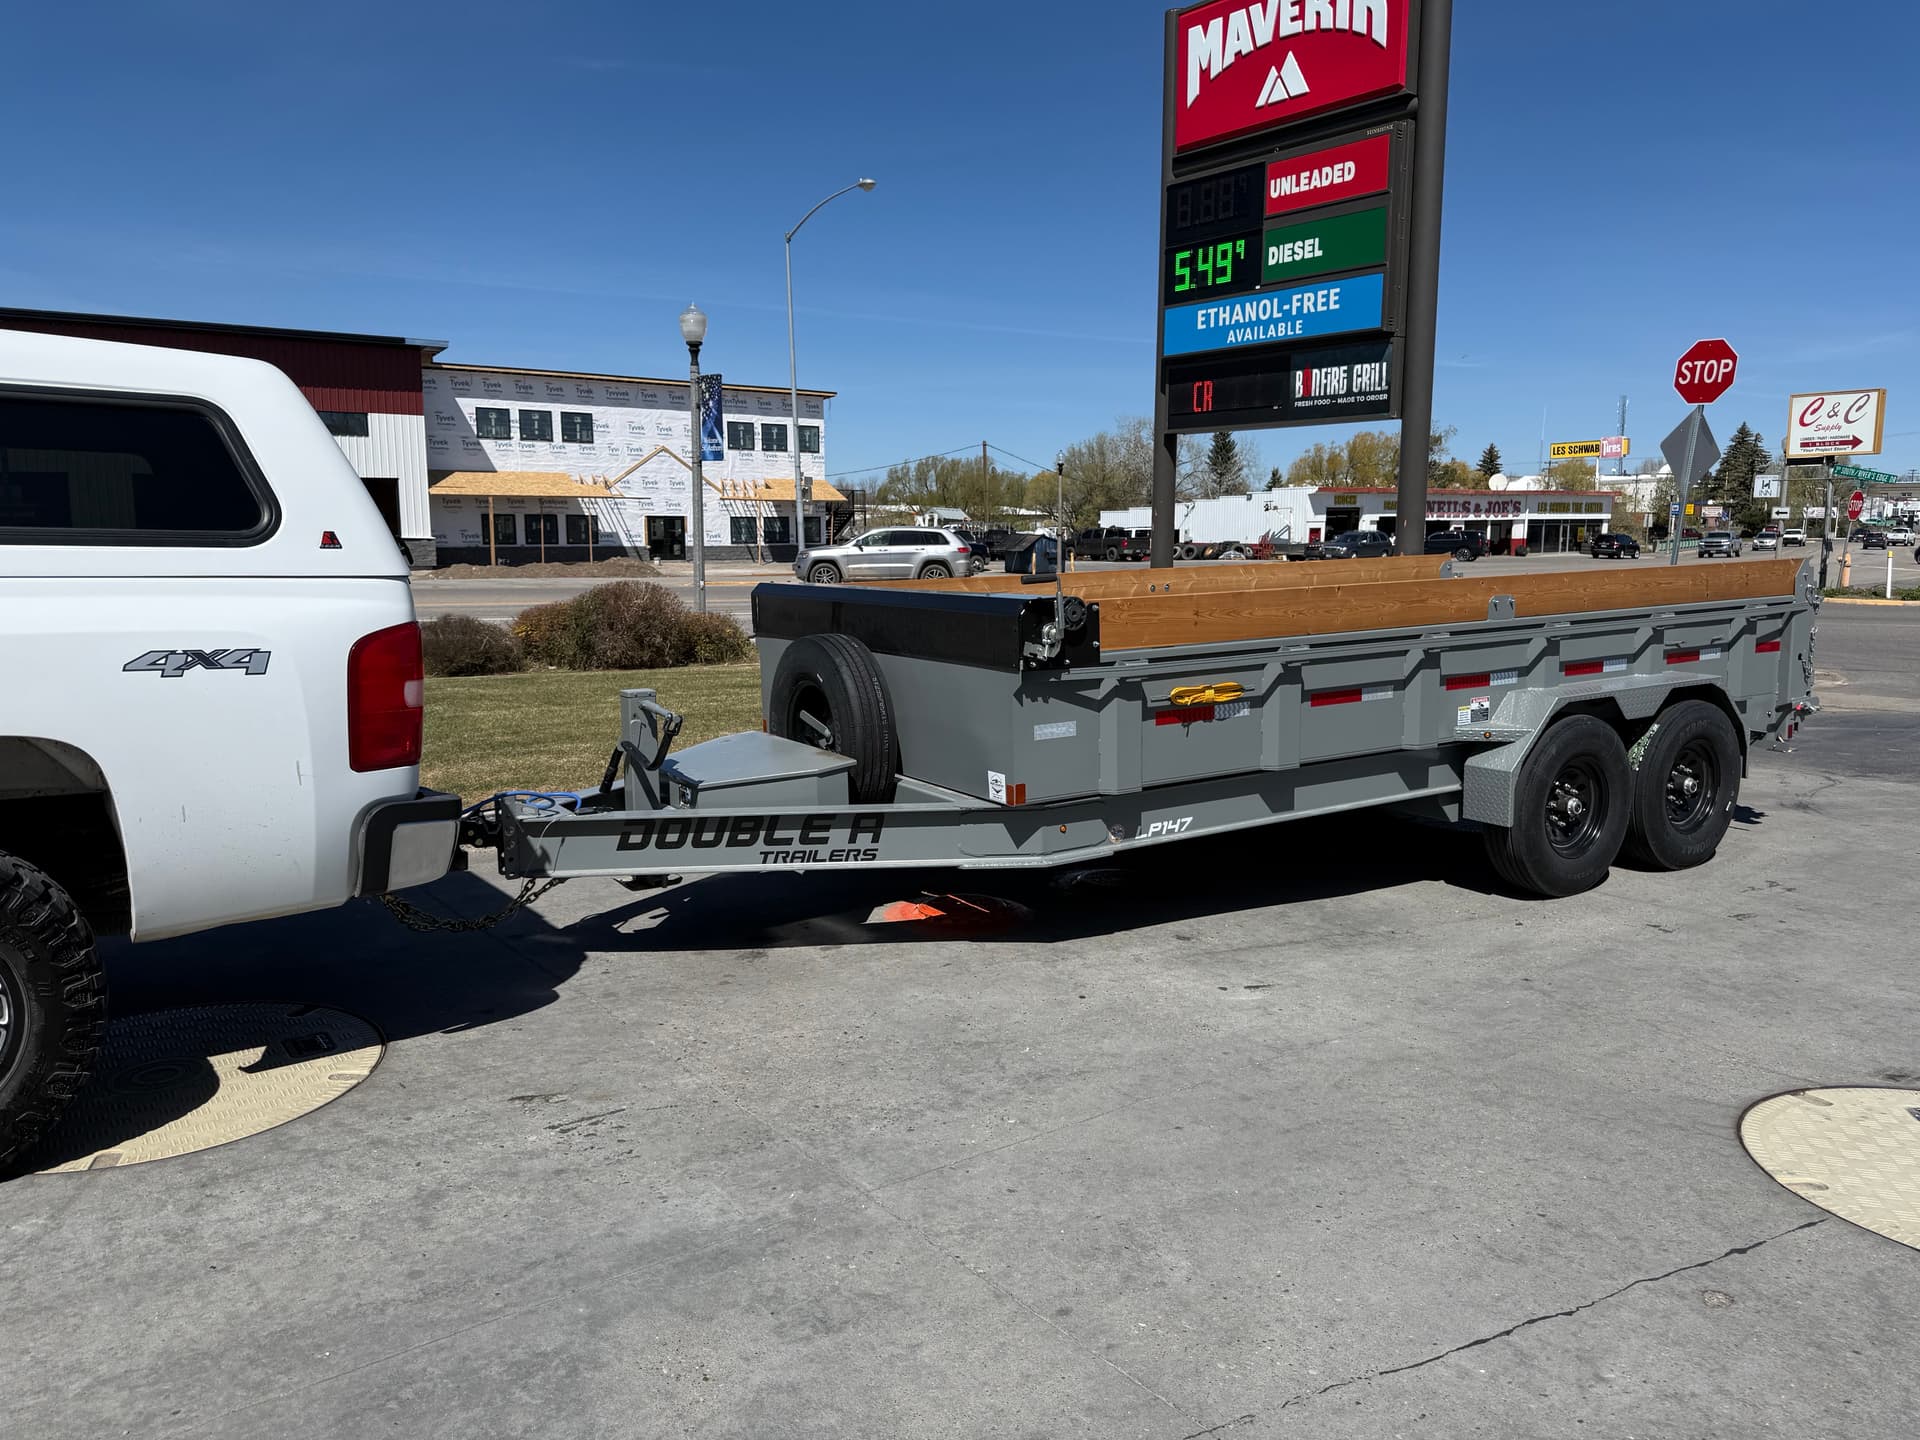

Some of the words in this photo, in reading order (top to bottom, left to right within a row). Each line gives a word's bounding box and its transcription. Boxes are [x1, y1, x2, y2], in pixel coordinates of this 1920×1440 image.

[1270, 160, 1356, 199] UNLEADED
[1267, 237, 1323, 266] DIESEL
[1196, 287, 1341, 330] ETHANOL-FREE
[1226, 320, 1304, 344] AVAILABLE
[1678, 358, 1734, 385] STOP
[449, 379, 470, 387] Tyvek
[545, 385, 564, 393] Tyvek
[640, 391, 657, 399] Tyvek
[1192, 380, 1213, 413] CR
[1294, 400, 1314, 408] FRESH
[1337, 396, 1356, 405] MADE
[1365, 393, 1388, 402] ORDER
[1798, 396, 1825, 428] C
[1827, 401, 1841, 419] &
[1843, 393, 1871, 425] C
[435, 414, 455, 422] Tyvek
[593, 422, 609, 430] Tyvek
[1813, 422, 1842, 433] Supply
[428, 439, 448, 447] Tyvek
[549, 443, 566, 451] Tyvek
[1552, 446, 1566, 456] LES
[1567, 443, 1600, 455] SCHWAB
[1601, 439, 1621, 457] Tires
[1848, 499, 1863, 512] STOP
[460, 532, 480, 541] Tyvek
[616, 814, 837, 851] DOUBLE
[848, 812, 885, 844] A
[759, 848, 879, 865] TRAILERS
